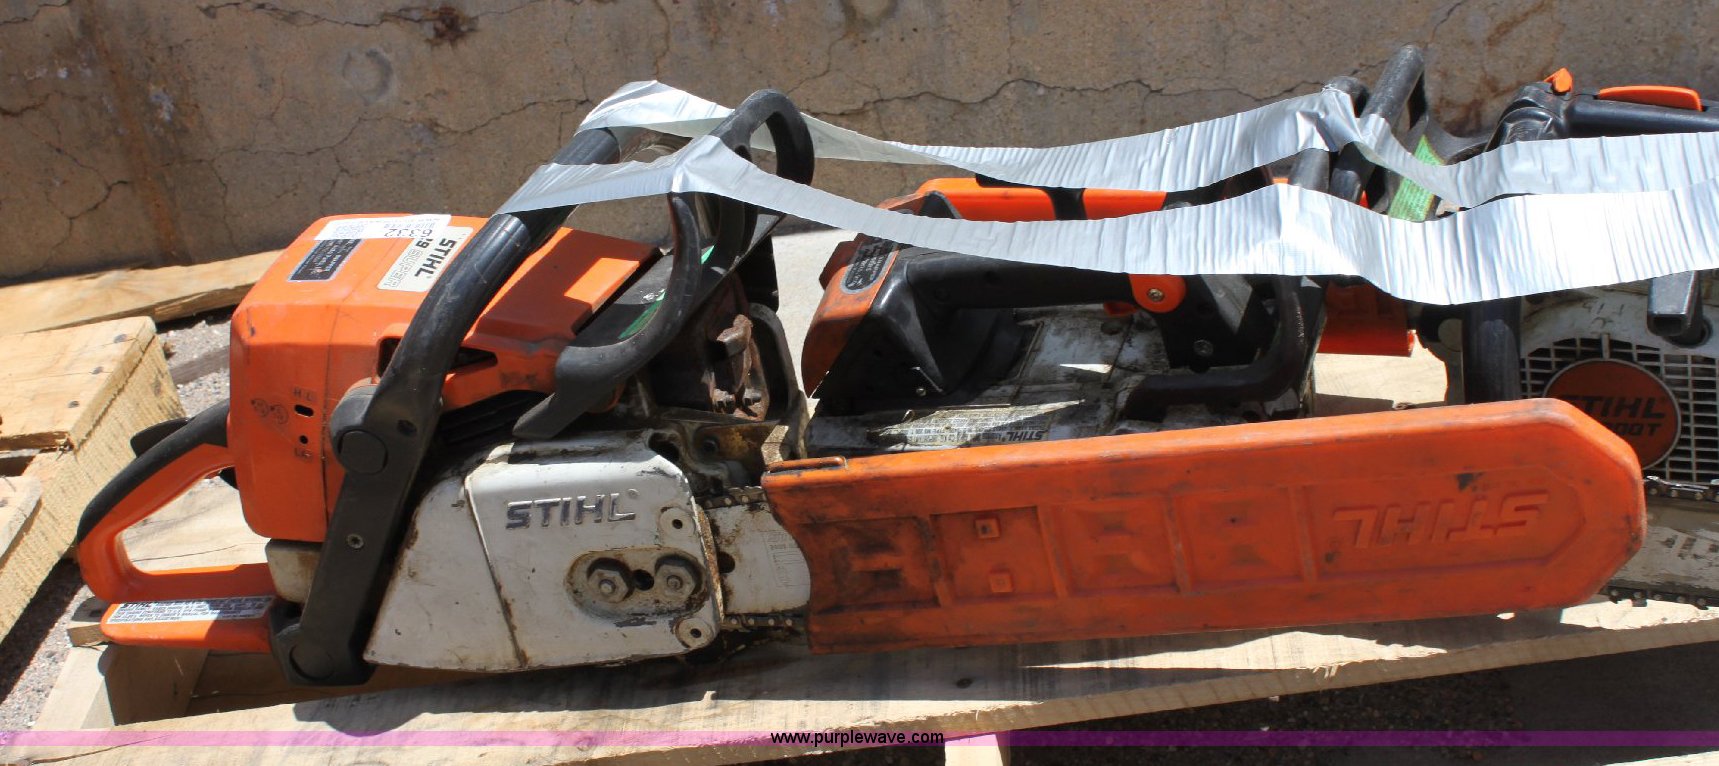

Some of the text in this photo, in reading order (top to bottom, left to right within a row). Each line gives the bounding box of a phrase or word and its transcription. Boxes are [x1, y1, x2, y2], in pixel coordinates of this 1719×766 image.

[382, 249, 424, 288] SUPER
[413, 238, 458, 278] STIHL
[1561, 395, 1666, 419] TIHL
[1006, 430, 1044, 442] STIHL
[1606, 422, 1664, 437] 00T
[505, 492, 637, 530] STIHL
[1332, 488, 1549, 550] STIHL
